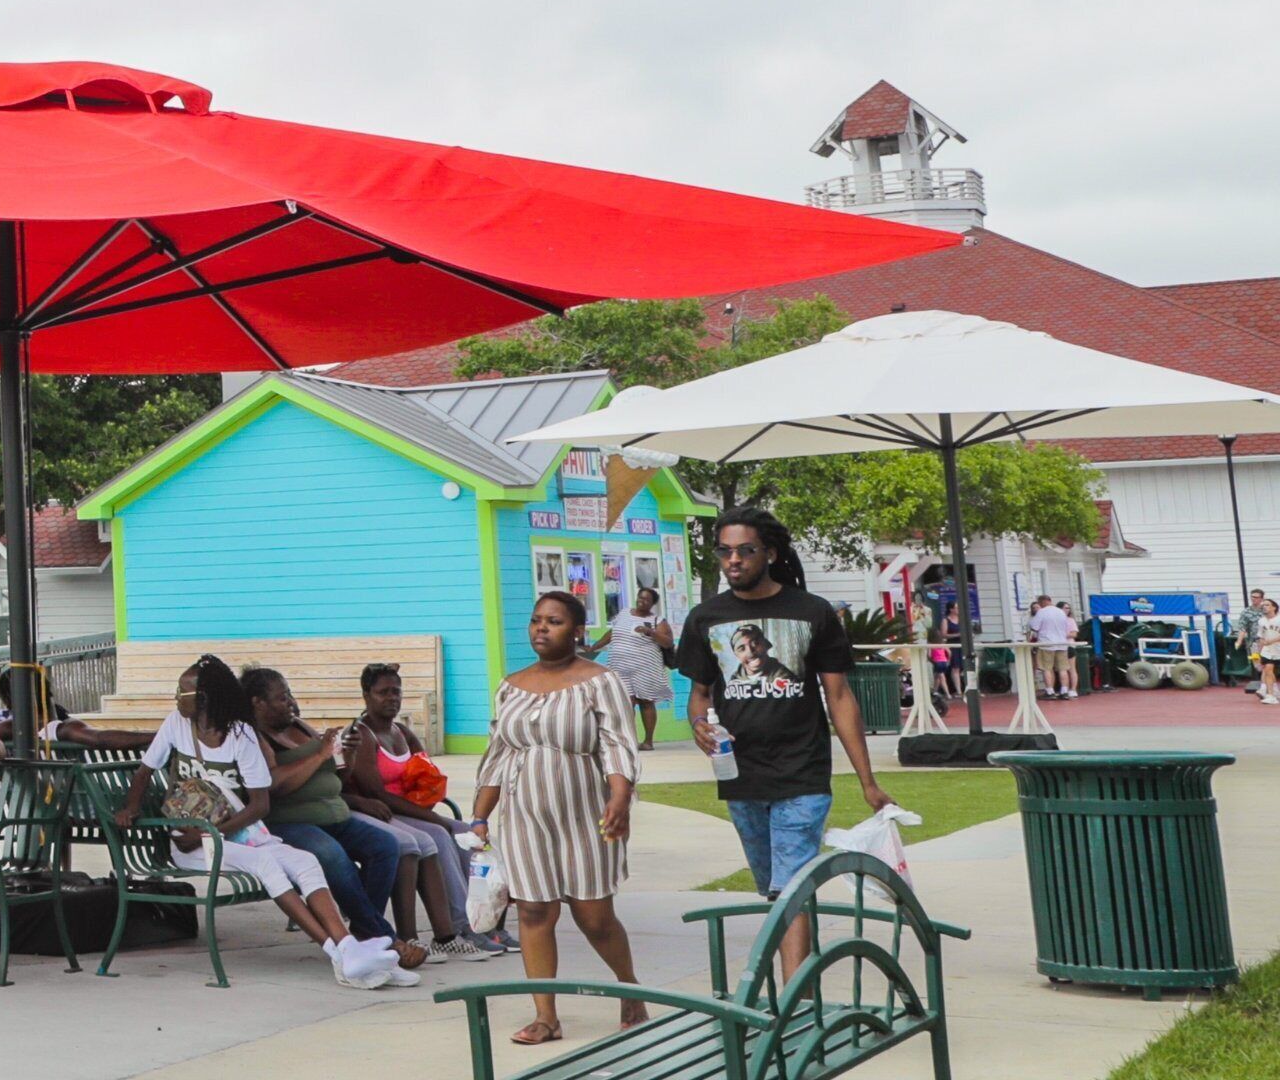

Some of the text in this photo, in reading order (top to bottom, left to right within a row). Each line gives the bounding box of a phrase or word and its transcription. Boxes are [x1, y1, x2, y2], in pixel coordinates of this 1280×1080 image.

[532, 512, 559, 528] PICK UP
[632, 520, 654, 533] ORDER
